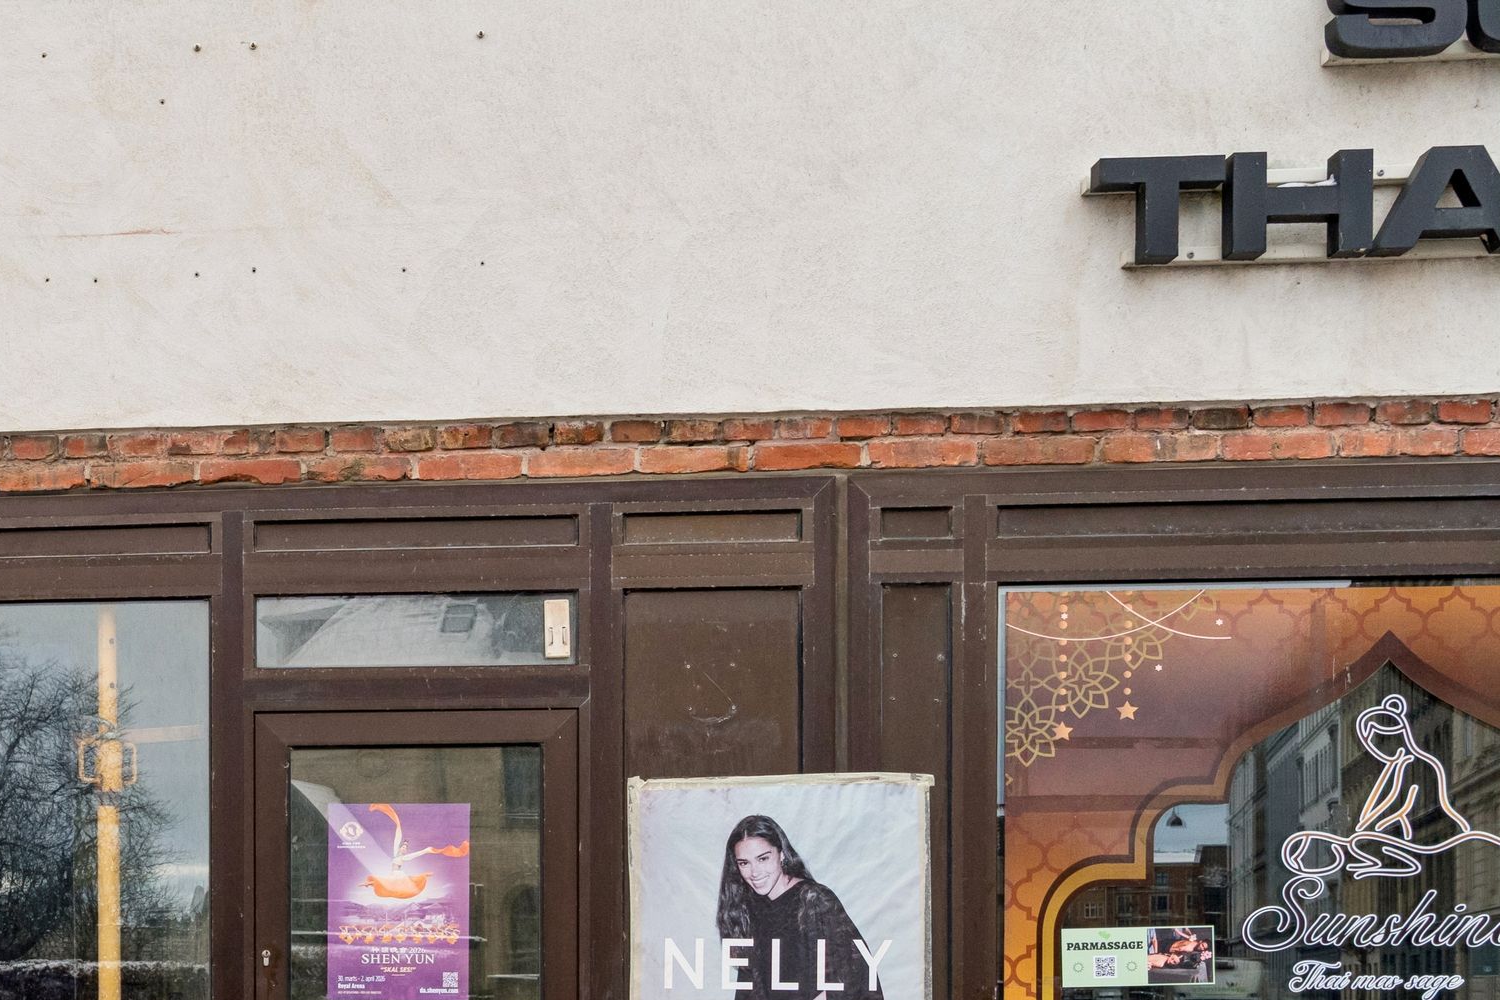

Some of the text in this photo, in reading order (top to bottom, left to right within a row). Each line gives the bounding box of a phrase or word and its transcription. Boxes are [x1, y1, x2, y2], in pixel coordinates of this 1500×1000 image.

[1066, 940, 1144, 951] PARMASSAGE
[361, 954, 435, 964] SHEN YUN
[663, 937, 893, 992] NELLY
[1288, 960, 1351, 993] Thai
